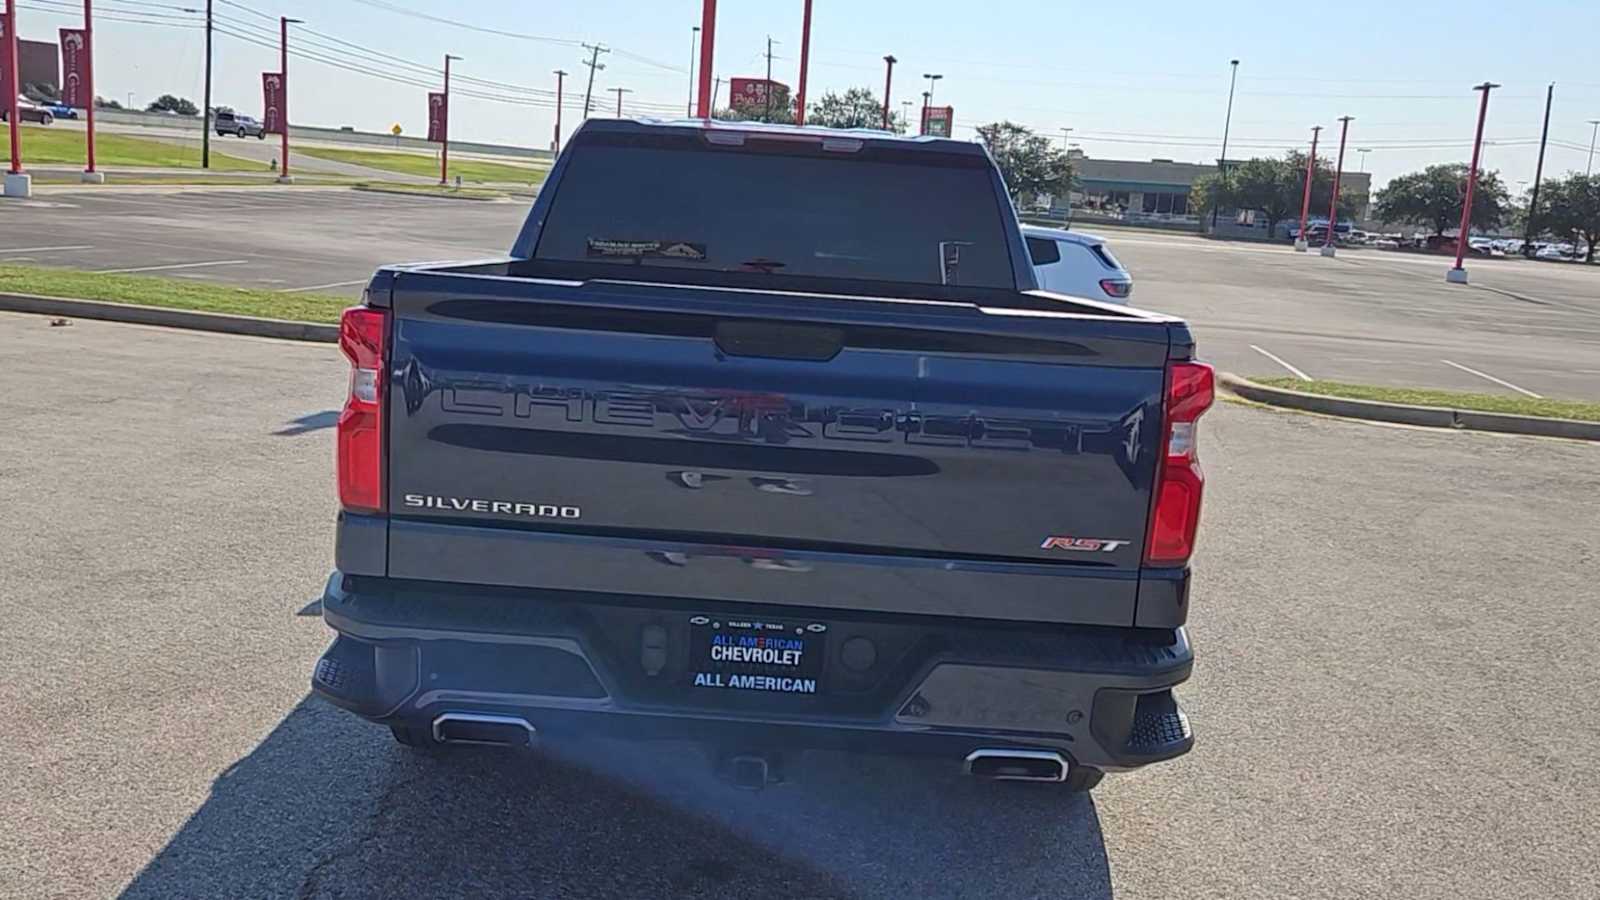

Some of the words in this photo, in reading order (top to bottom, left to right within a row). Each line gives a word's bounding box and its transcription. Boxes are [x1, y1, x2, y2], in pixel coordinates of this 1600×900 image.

[441, 379, 1113, 455] CHEVROLET
[404, 494, 581, 518] SILVERADO
[1040, 536, 1131, 552] RST
[713, 635, 737, 646] ALL
[739, 636, 803, 650] AMERICAN
[711, 645, 802, 665] CHEVROLET
[694, 673, 725, 687] ALL
[728, 675, 816, 693] AMERICAN
